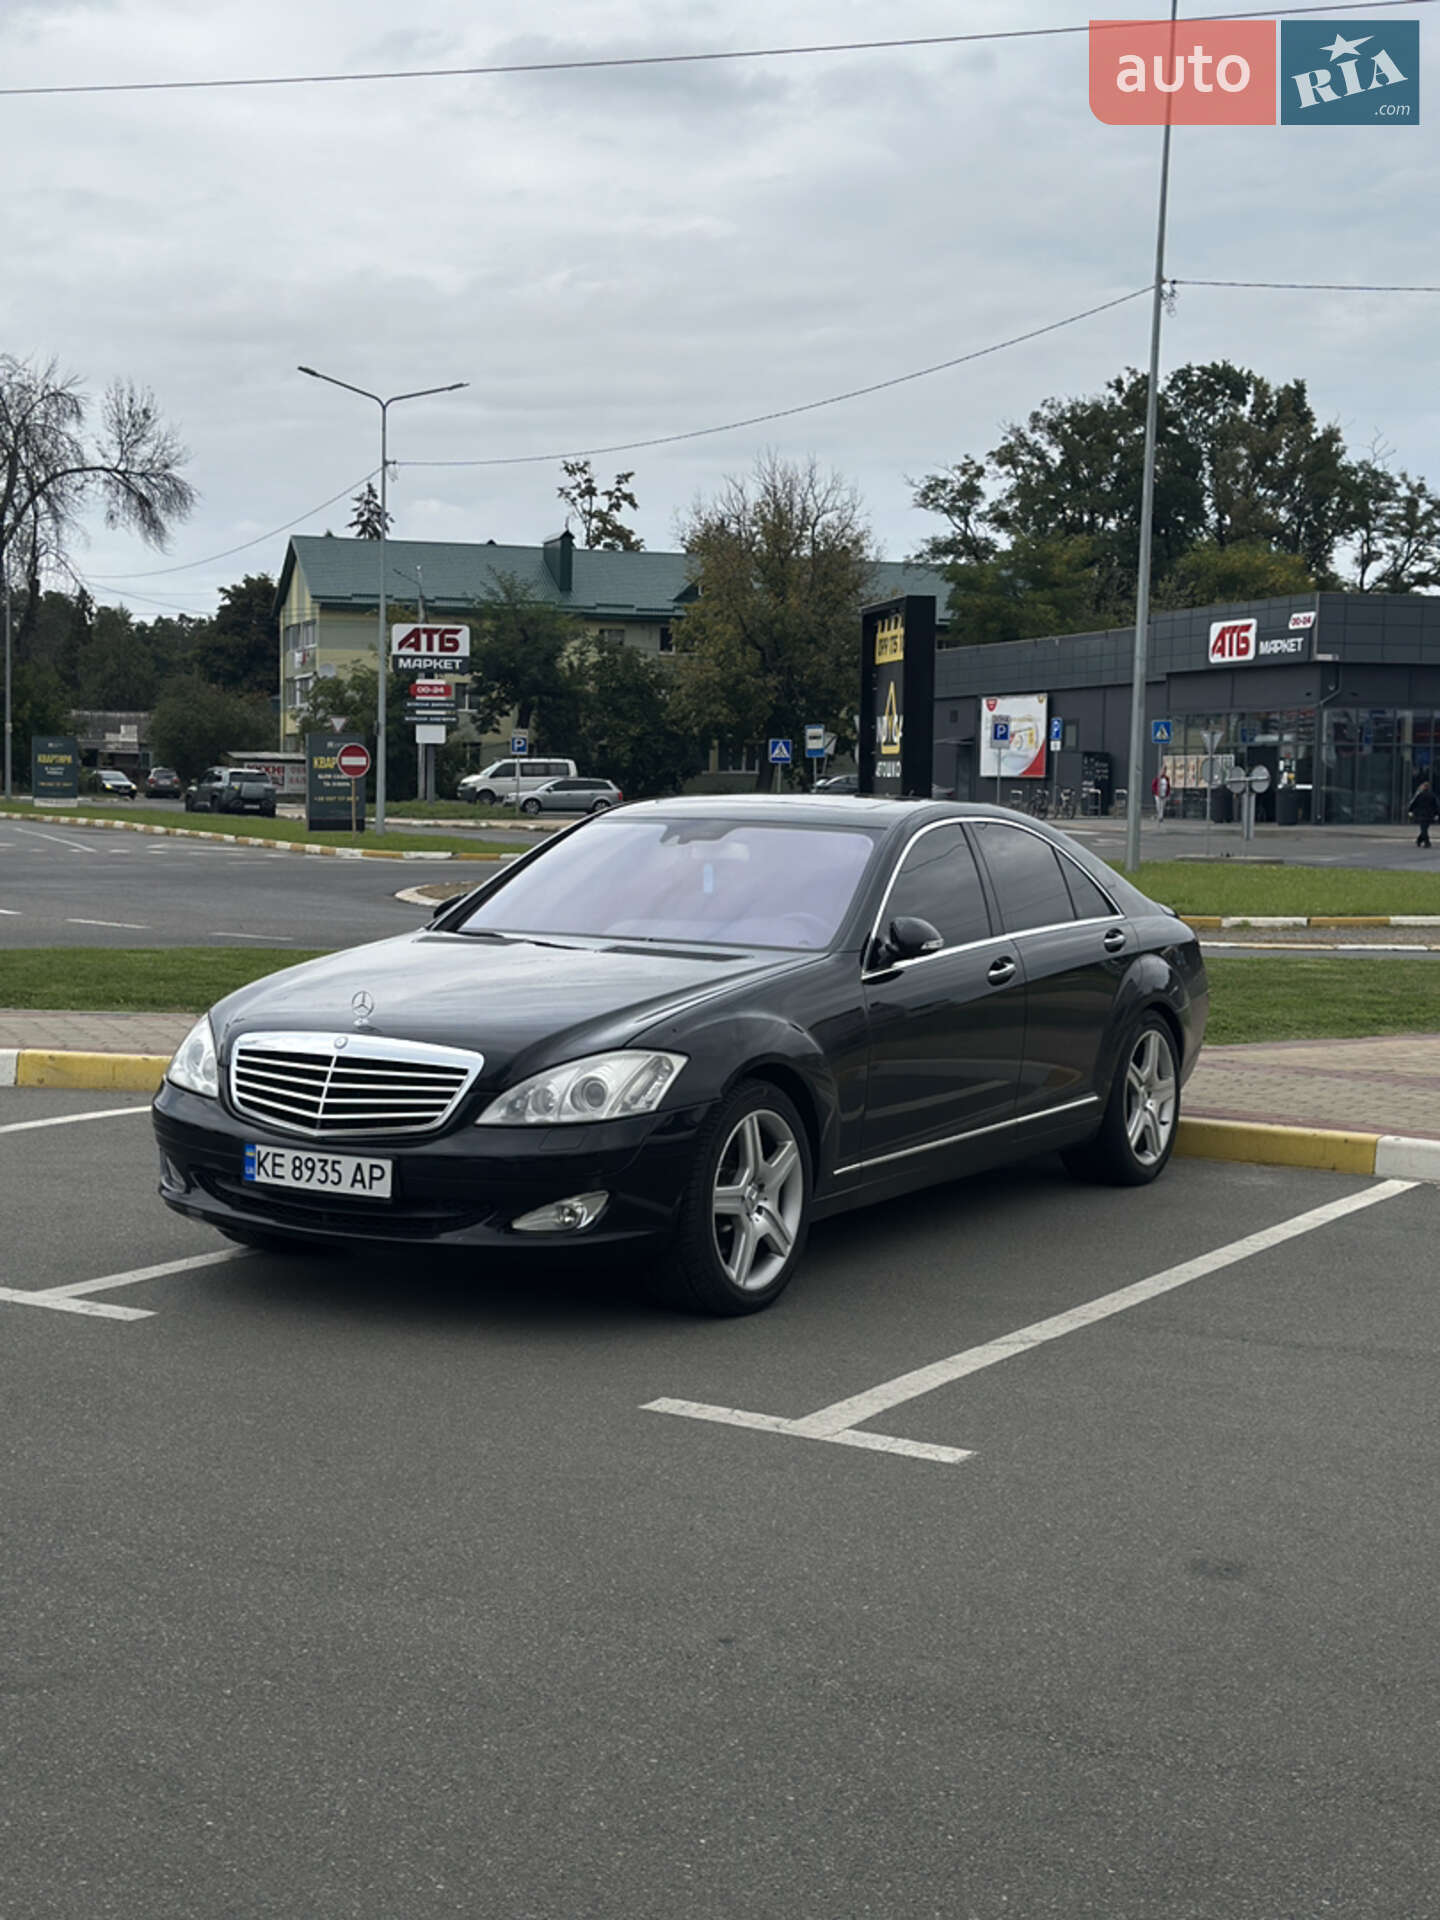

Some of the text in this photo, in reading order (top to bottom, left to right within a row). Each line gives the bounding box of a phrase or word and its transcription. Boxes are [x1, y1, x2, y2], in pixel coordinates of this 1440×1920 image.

[398, 627, 464, 653] АТБ
[1259, 637, 1304, 655] МАРКЕТ
[398, 658, 462, 670] МАРКЕТ
[514, 738, 525, 751] P
[257, 1150, 386, 1190] KE 8935 AP
